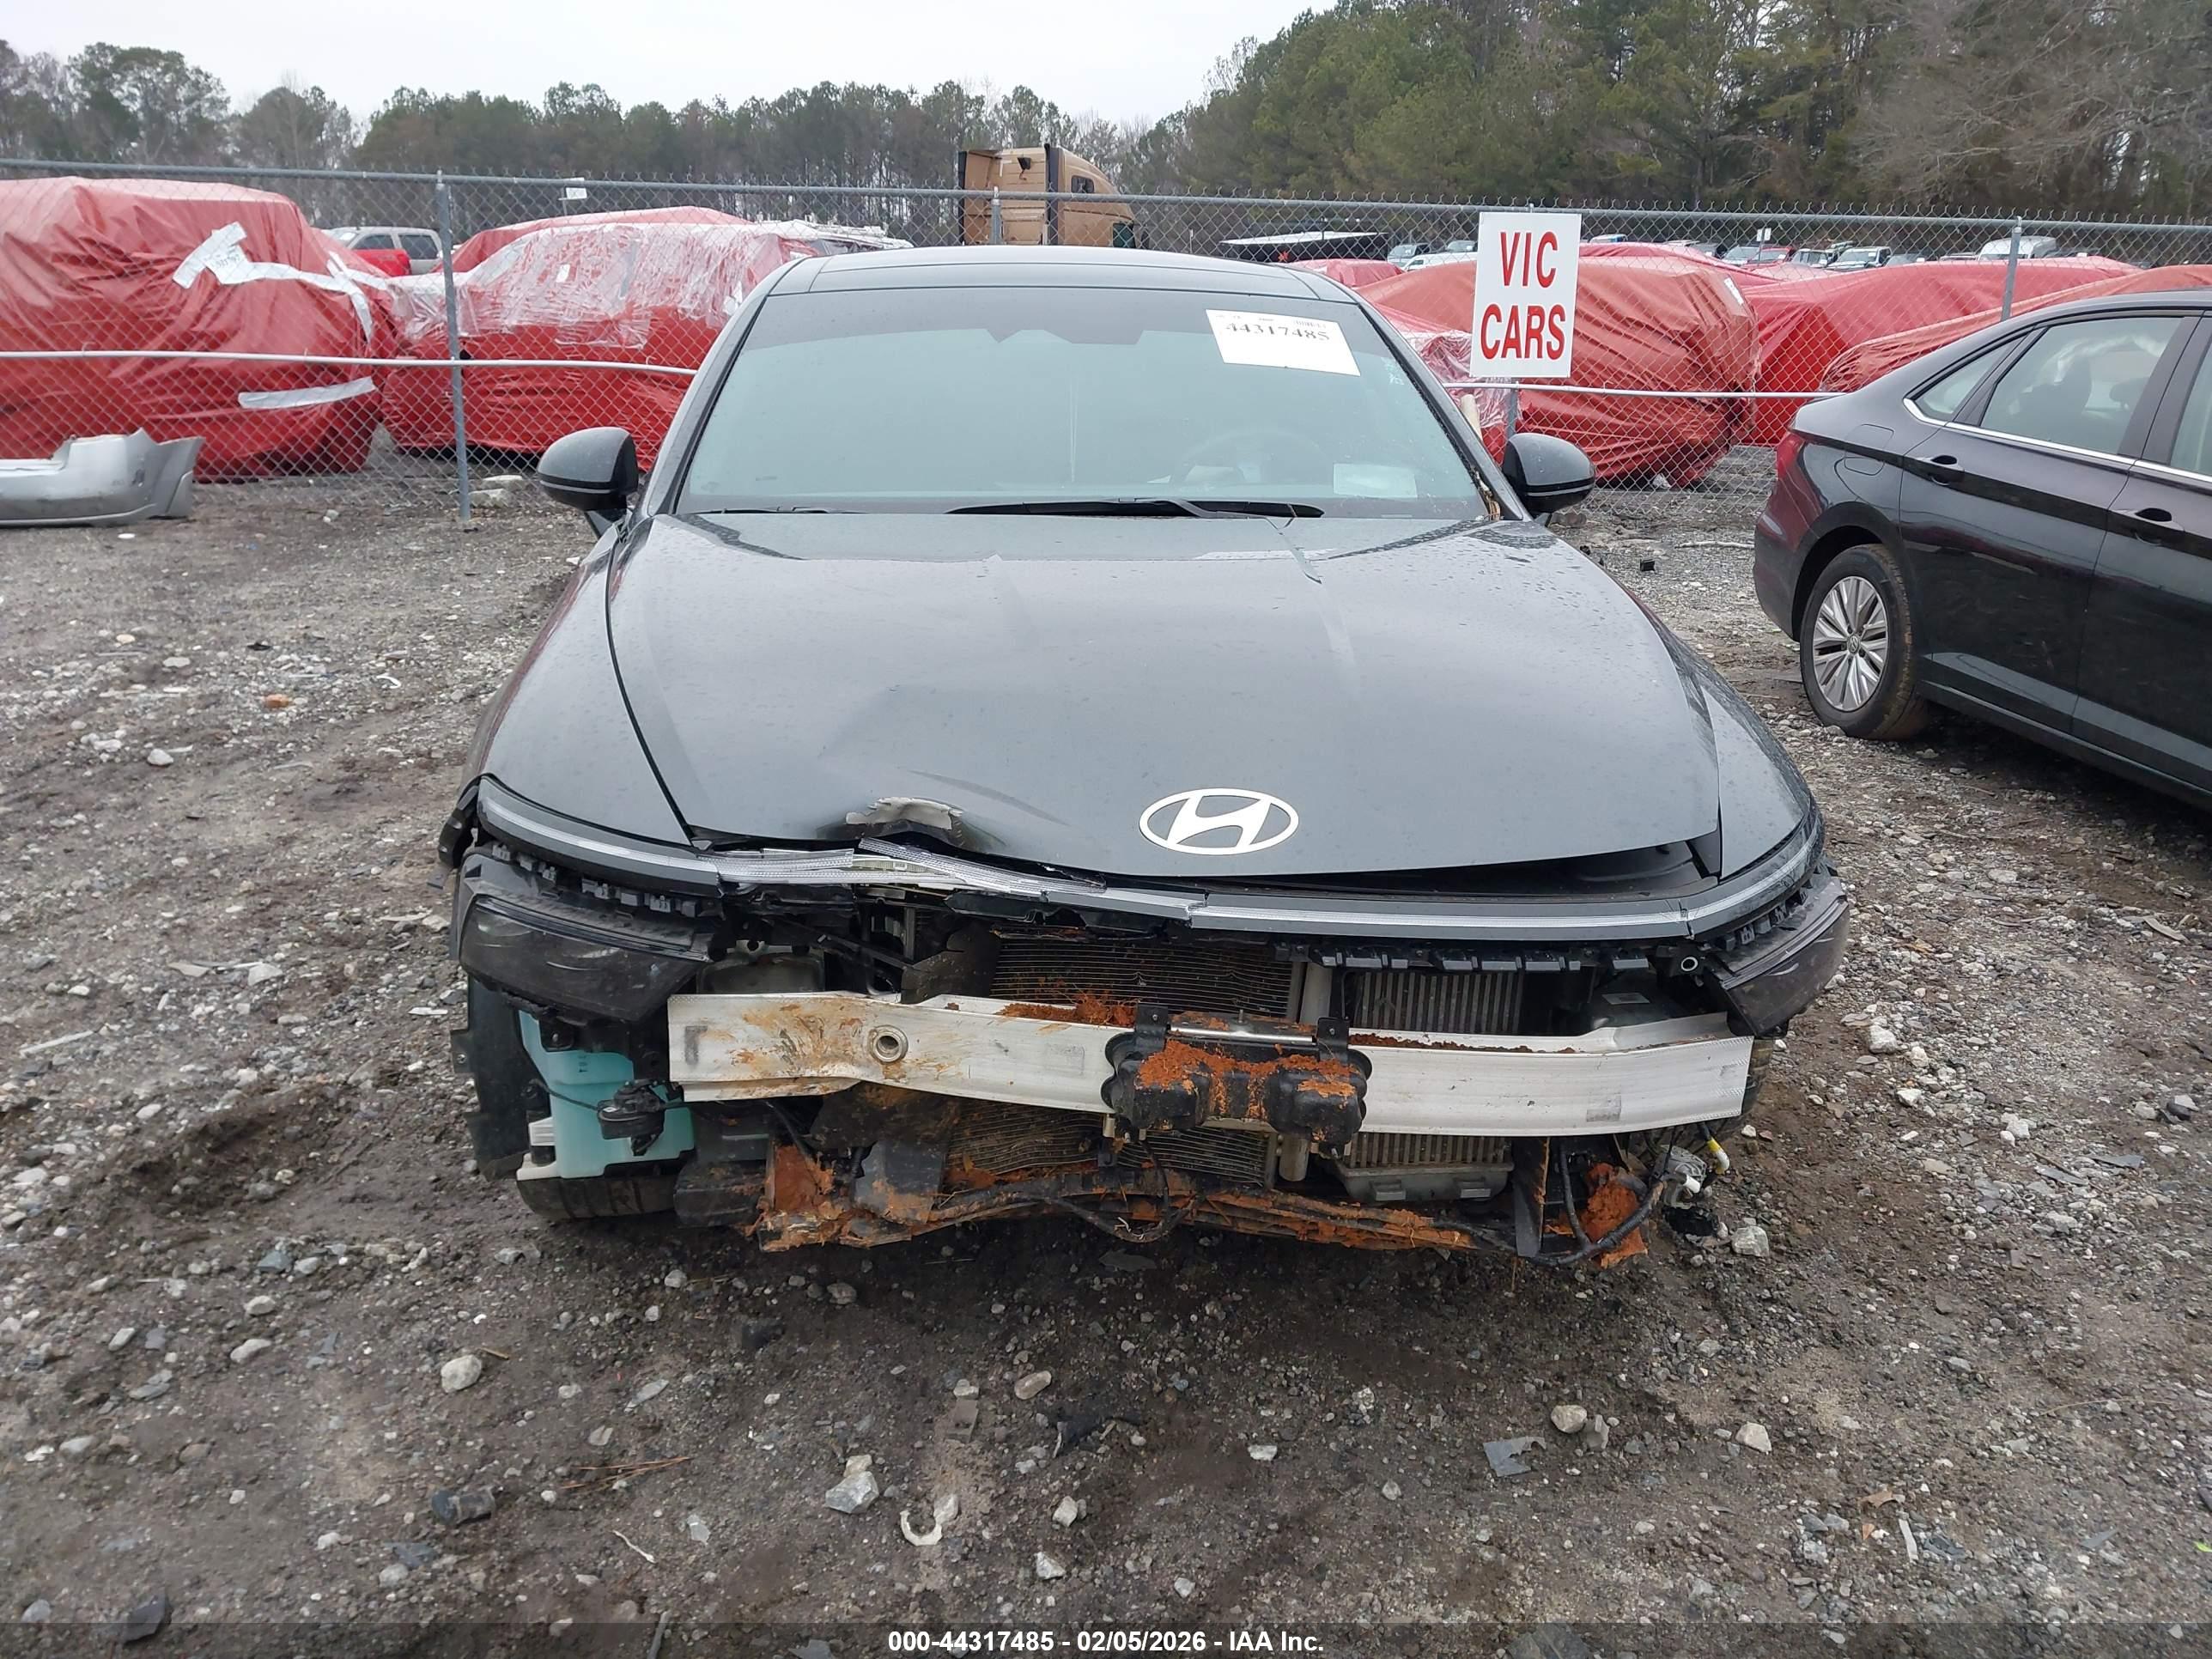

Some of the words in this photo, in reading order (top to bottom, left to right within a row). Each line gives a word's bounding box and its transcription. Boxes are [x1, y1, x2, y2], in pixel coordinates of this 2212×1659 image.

[1500, 232, 1558, 289] VIC
[1226, 322, 1330, 341] 44317485
[1480, 304, 1566, 361] CARS
